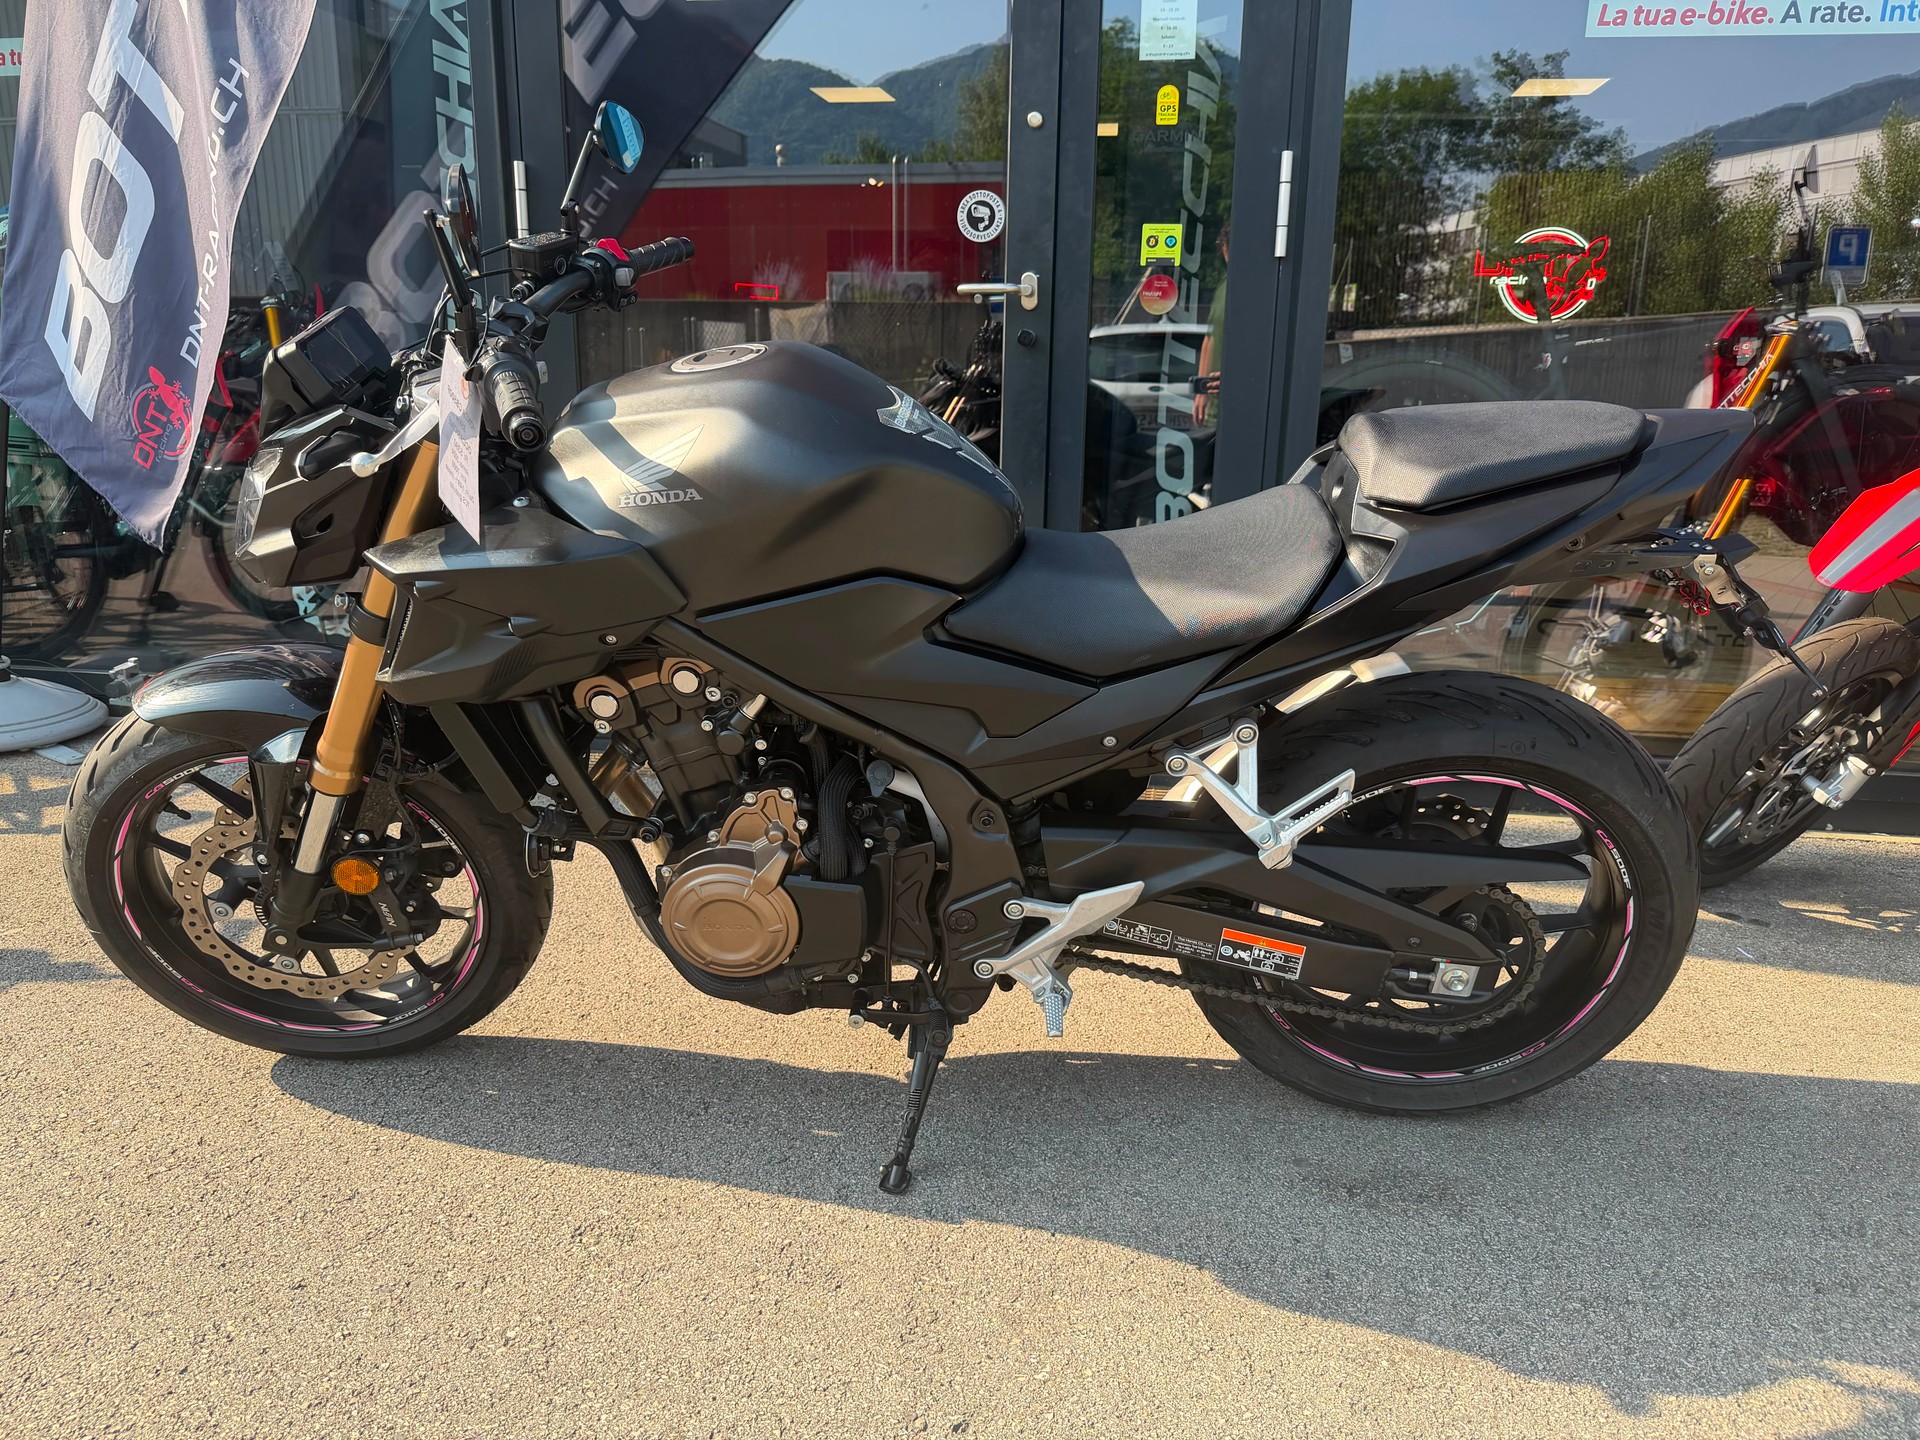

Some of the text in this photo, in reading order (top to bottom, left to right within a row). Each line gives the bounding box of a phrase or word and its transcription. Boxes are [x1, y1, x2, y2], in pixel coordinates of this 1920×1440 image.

[1597, 0, 1920, 27] La tua e-bike. A rate. Int
[1160, 105, 1177, 113] GPS
[43, 0, 190, 423] BOT
[133, 401, 167, 470] DNT
[156, 424, 173, 462] racing
[618, 488, 703, 508] HONDA
[702, 924, 754, 932] HONDA
